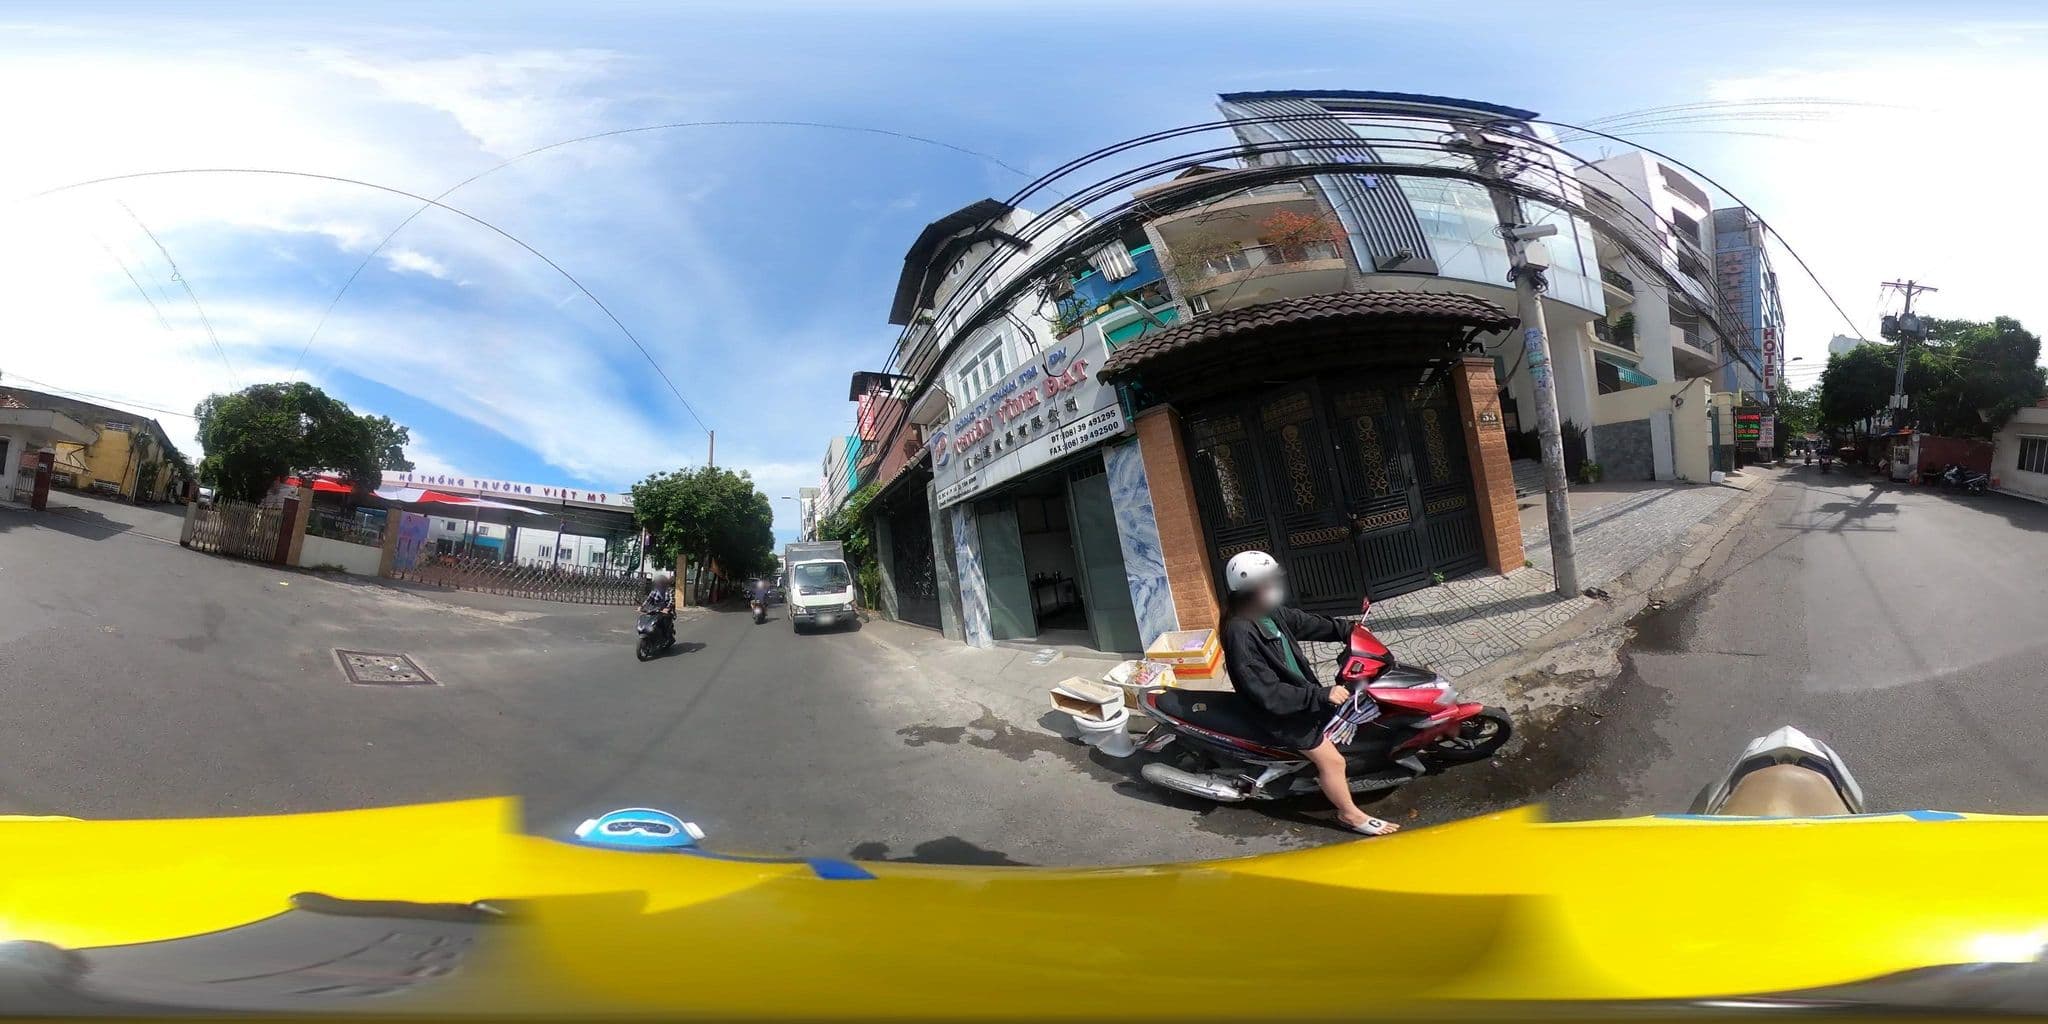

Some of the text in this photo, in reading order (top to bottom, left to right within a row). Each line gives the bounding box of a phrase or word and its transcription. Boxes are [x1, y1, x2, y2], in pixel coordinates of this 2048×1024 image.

[1763, 328, 1776, 389] HOTEL
[1077, 422, 1087, 433] 39
[1088, 409, 1116, 427] 491295
[1079, 433, 1089, 444] 39
[1089, 421, 1119, 439] 492500
[420, 474, 465, 487] THỐNG
[473, 479, 532, 494] TRƯỜNG
[543, 487, 578, 500] VIỆT
